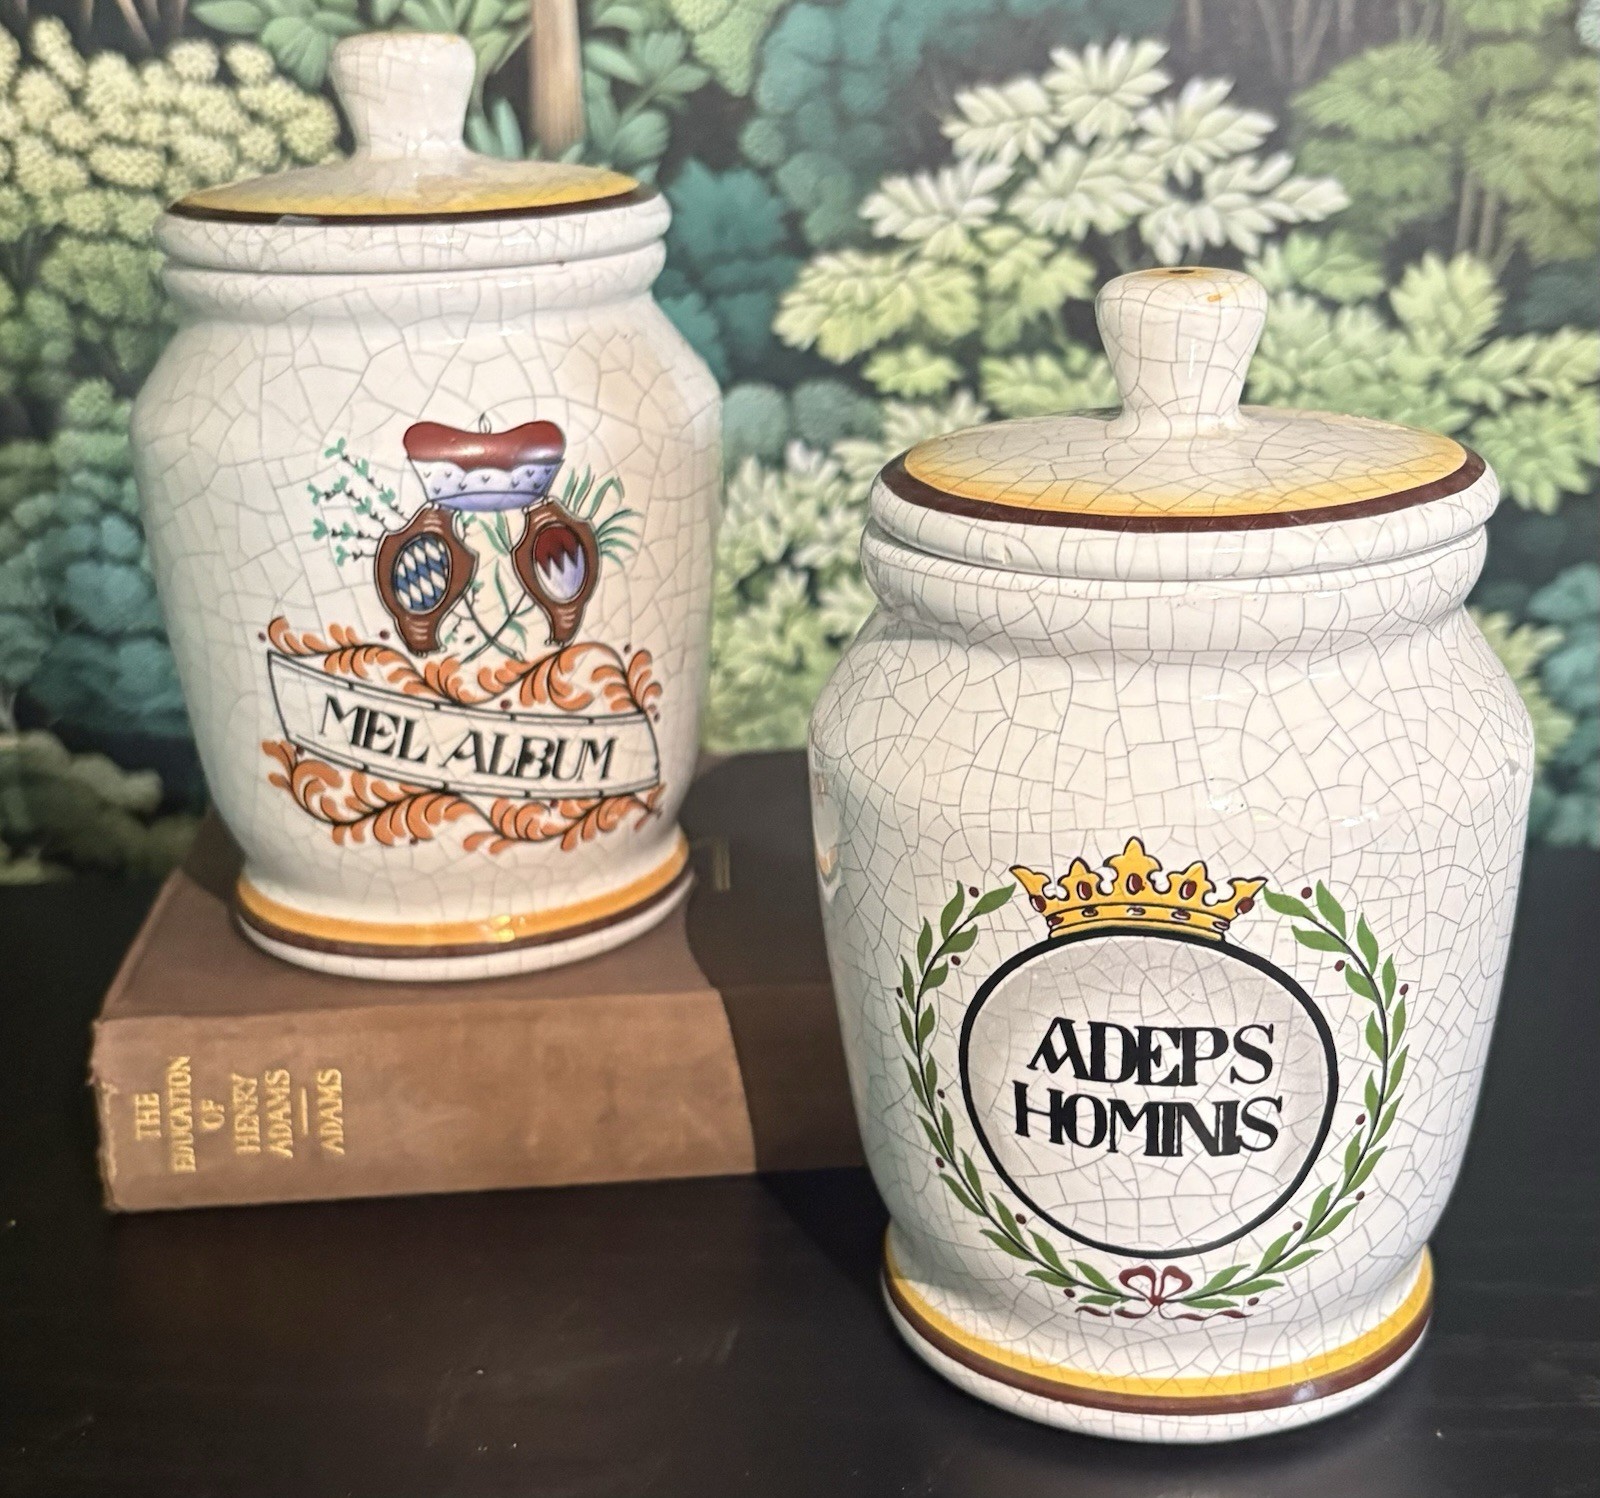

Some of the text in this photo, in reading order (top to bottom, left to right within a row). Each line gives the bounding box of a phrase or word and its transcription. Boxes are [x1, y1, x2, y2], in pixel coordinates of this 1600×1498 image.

[318, 694, 619, 782] MEL ALBUM
[1026, 1016, 1274, 1087] ADEPS
[134, 1093, 161, 1141] THE
[168, 1055, 197, 1173] EDUCATION
[201, 1099, 225, 1132] OF
[231, 1072, 261, 1155] HENRY
[265, 1069, 293, 1159] ADAMS
[316, 1069, 345, 1156] ADAMS
[1012, 1080, 1283, 1157] HOMINIS
